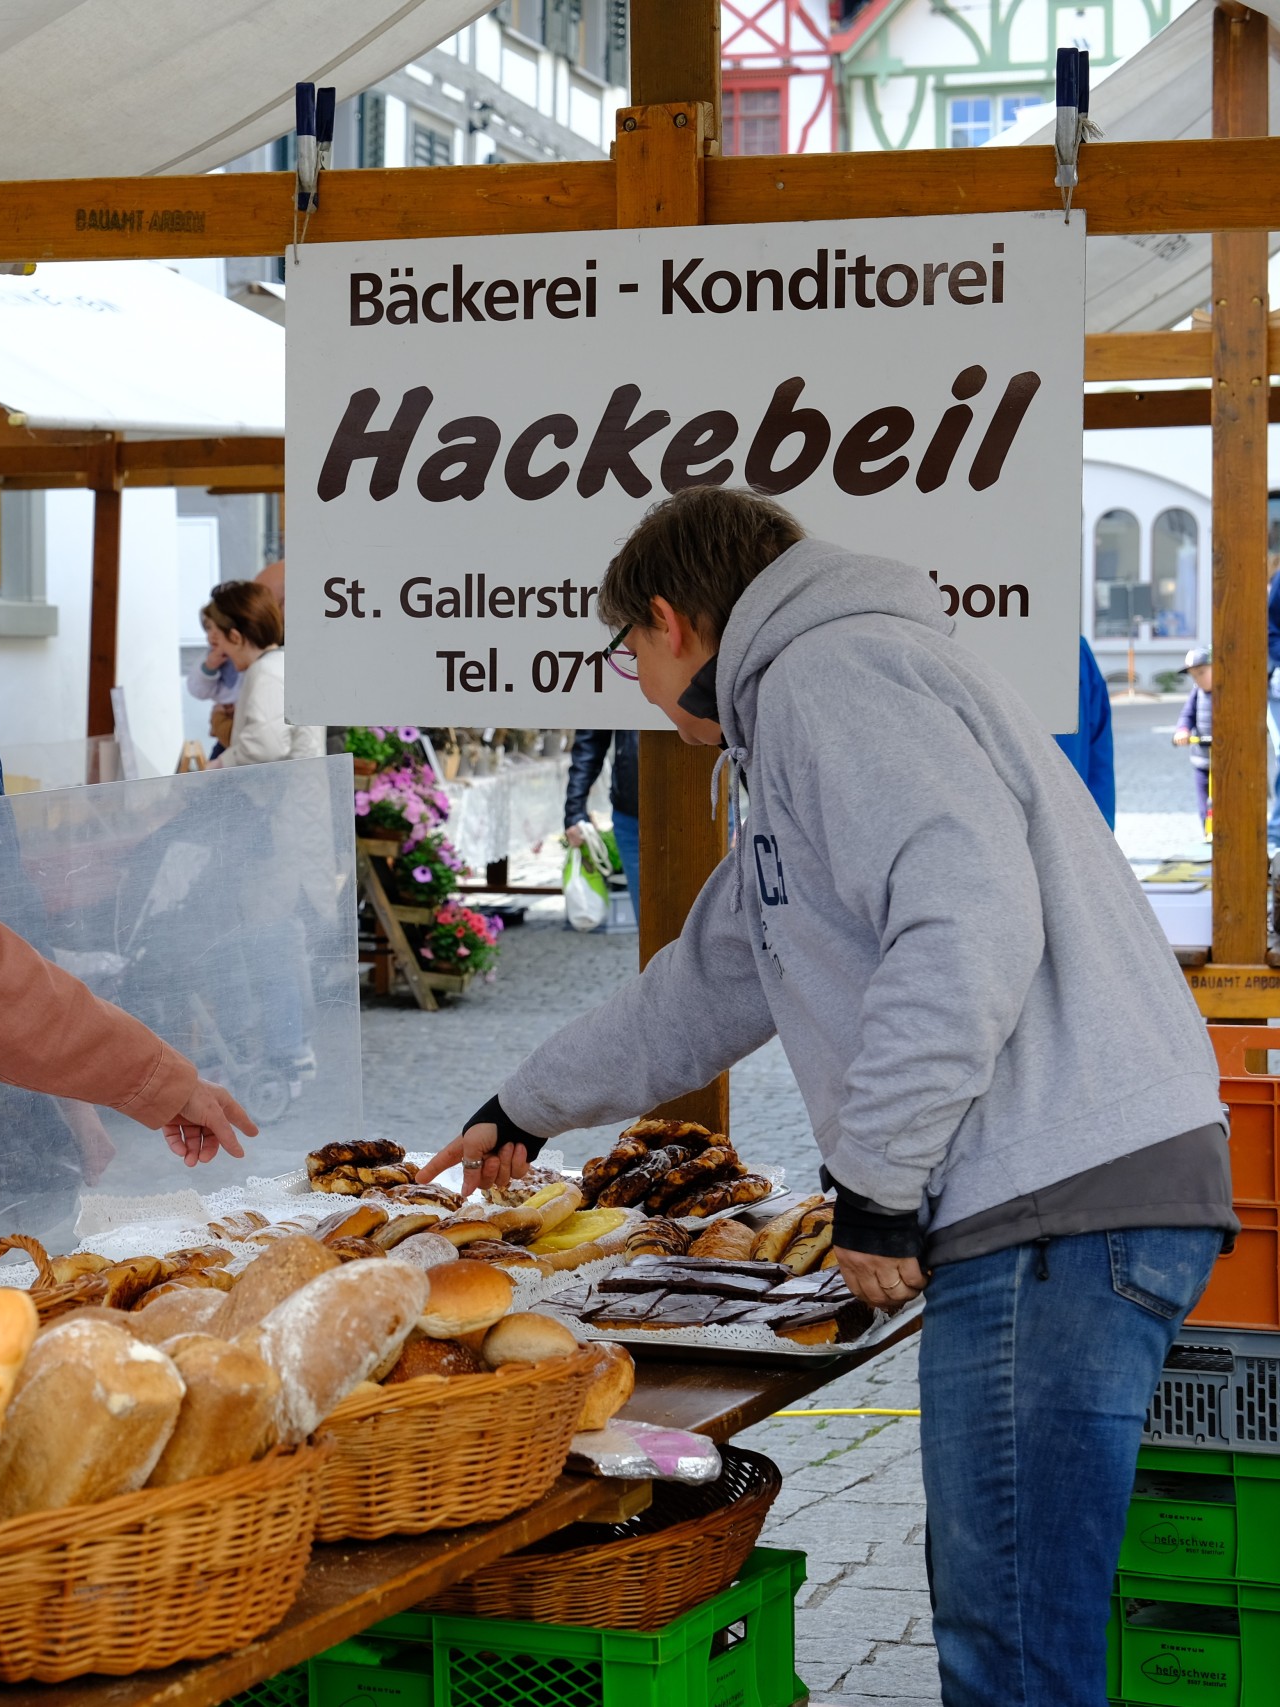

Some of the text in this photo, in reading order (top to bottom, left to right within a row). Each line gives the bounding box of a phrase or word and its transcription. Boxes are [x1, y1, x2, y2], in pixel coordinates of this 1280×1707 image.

[75, 208, 144, 232] BAUAMT
[350, 260, 596, 326] Bäckerei
[662, 243, 1004, 314] Konditorei
[317, 365, 1041, 503] Hackebeil
[324, 577, 381, 618] St.
[436, 648, 603, 693] Tel. 071
[1191, 975, 1241, 989] BAUAMT
